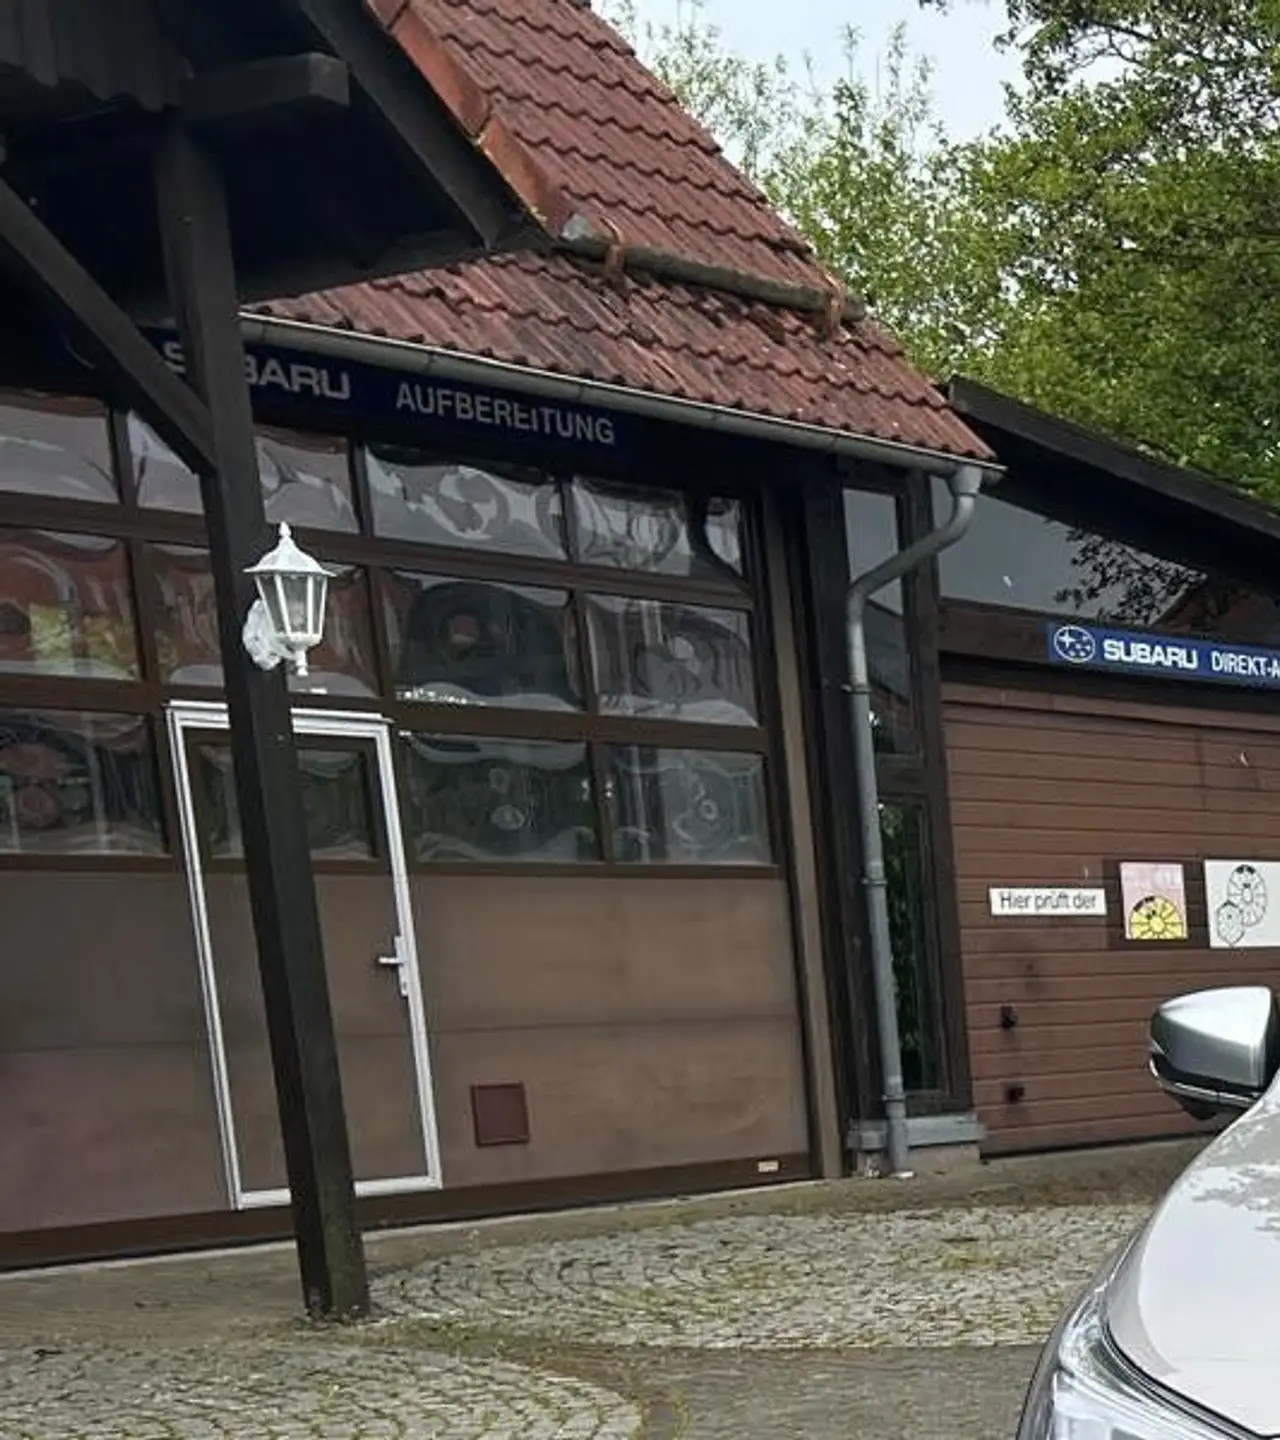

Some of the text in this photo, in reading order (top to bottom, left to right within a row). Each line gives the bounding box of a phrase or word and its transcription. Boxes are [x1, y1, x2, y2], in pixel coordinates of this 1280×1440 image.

[163, 341, 615, 444] SBARU AUFBEREITUNG
[1103, 639, 1199, 669] SUBARU
[1001, 891, 1032, 909] Hier
[1072, 891, 1097, 909] der
